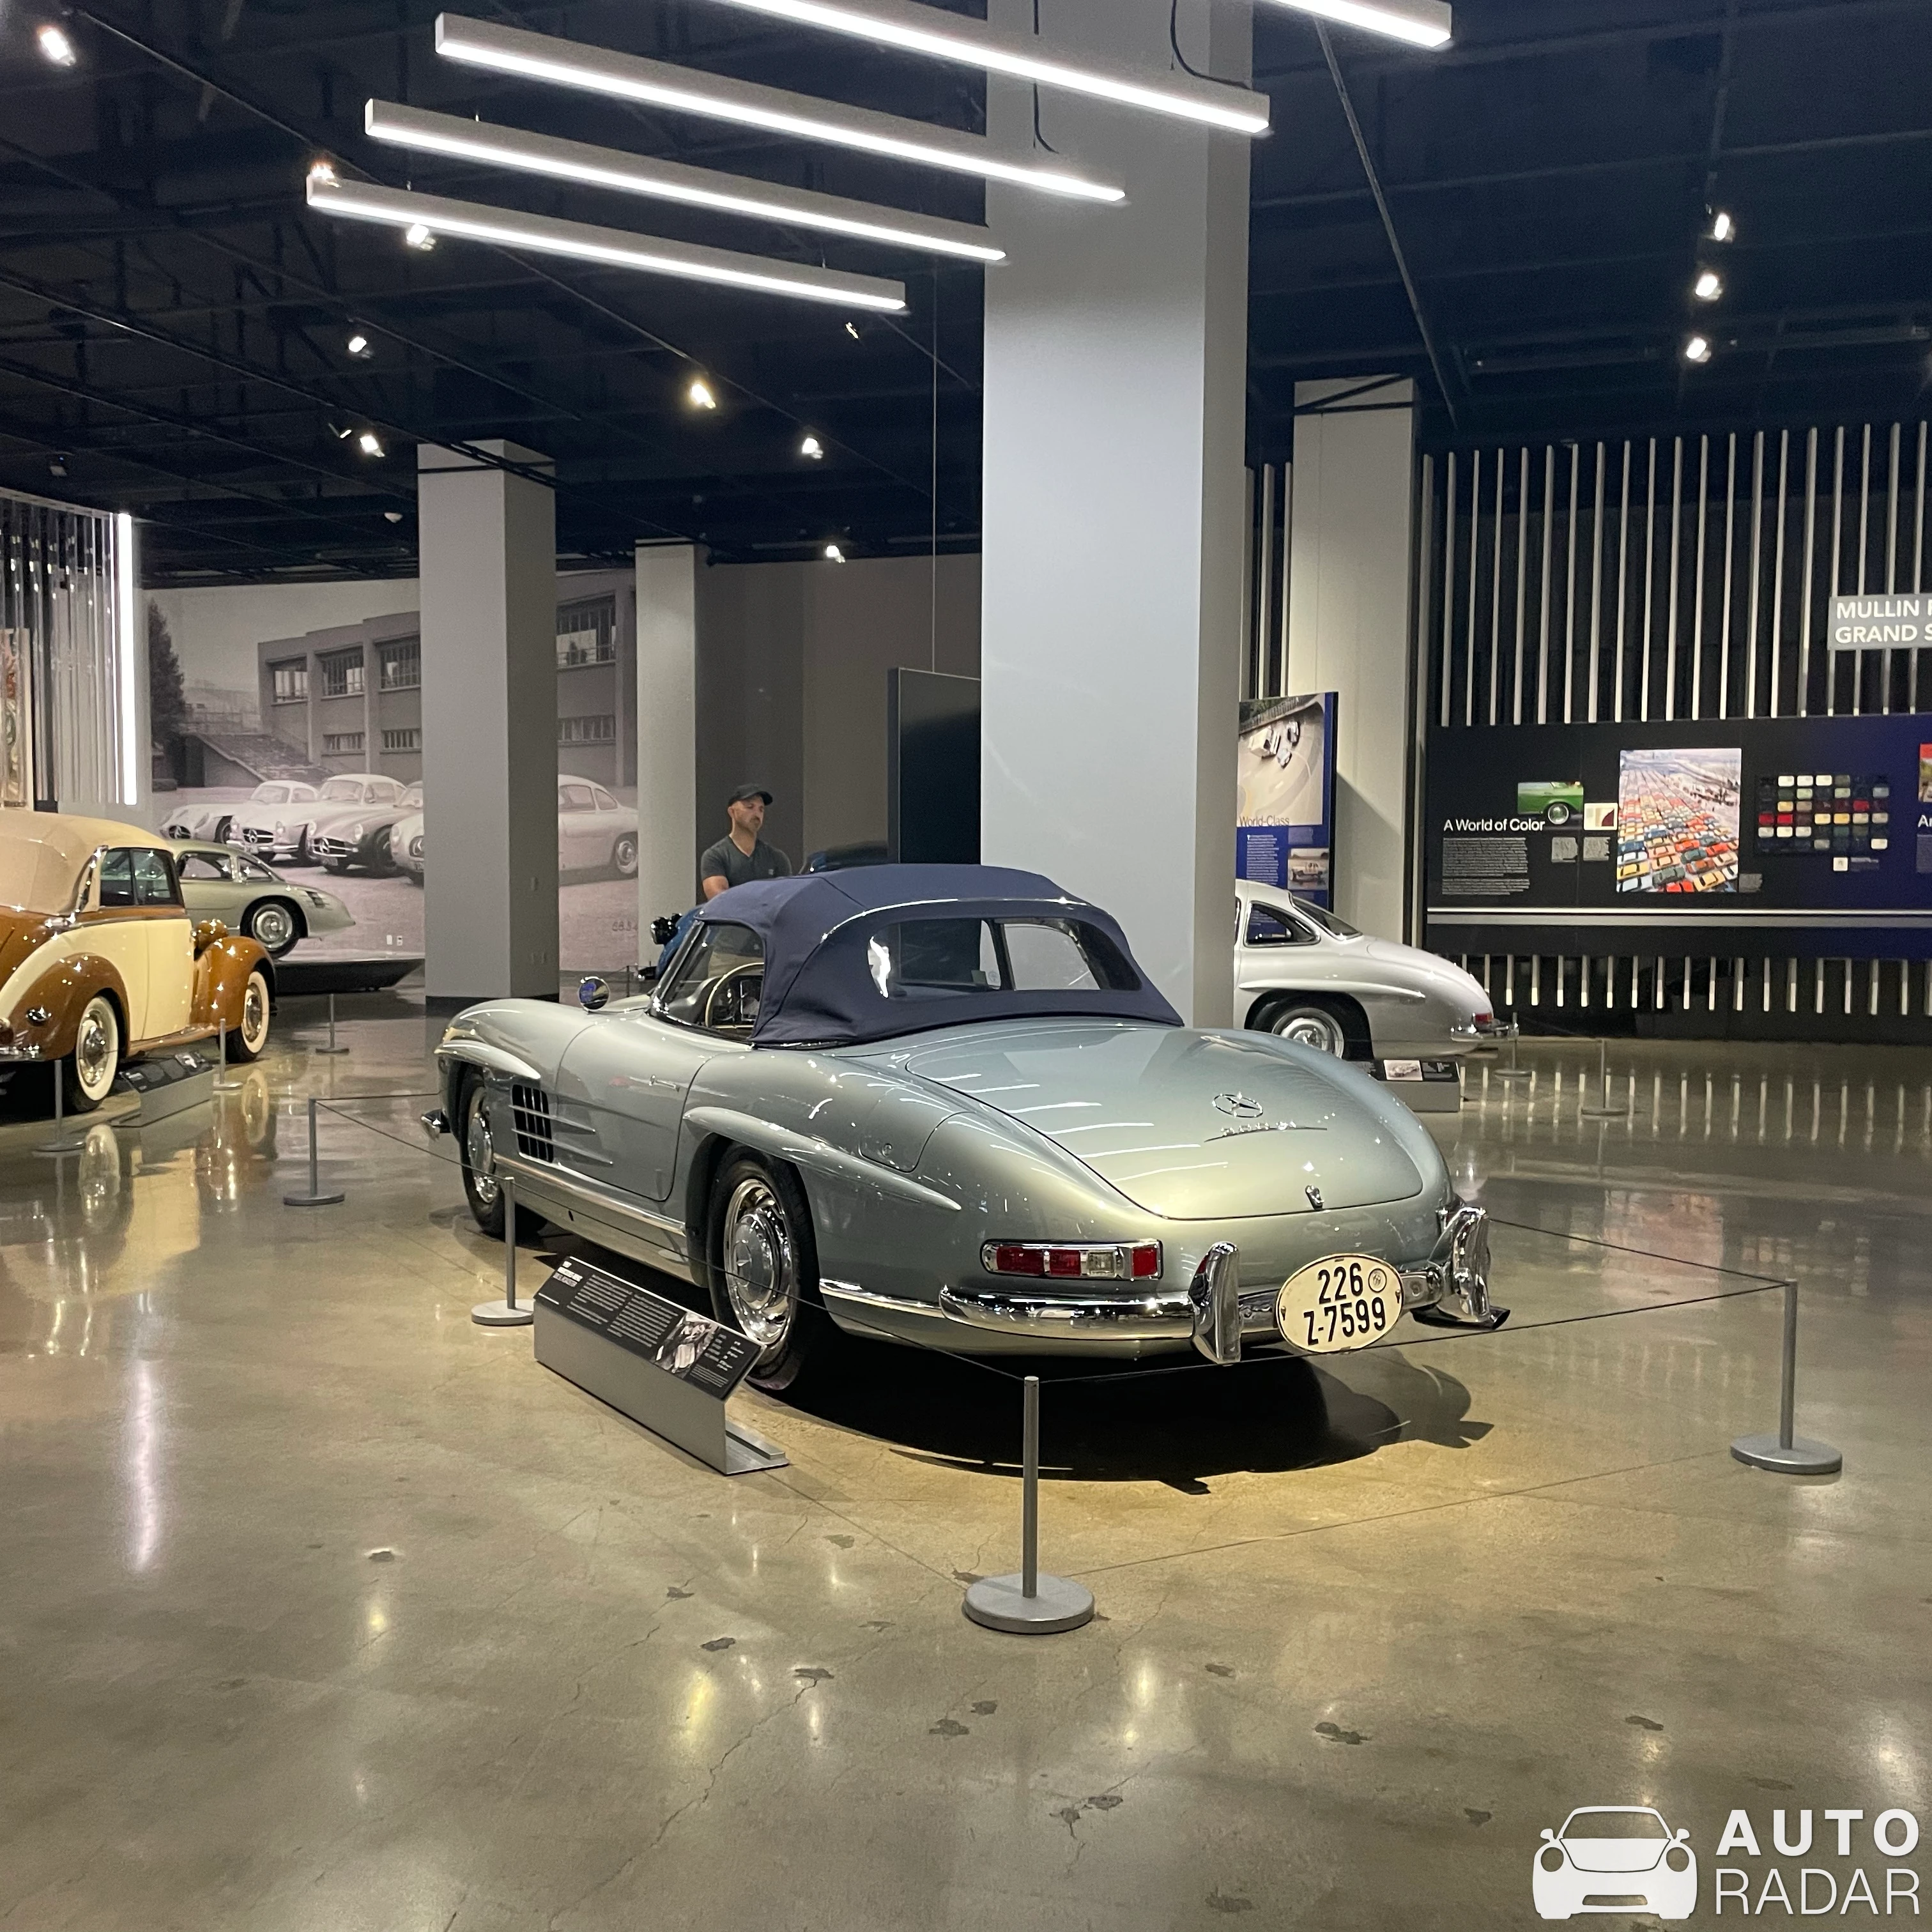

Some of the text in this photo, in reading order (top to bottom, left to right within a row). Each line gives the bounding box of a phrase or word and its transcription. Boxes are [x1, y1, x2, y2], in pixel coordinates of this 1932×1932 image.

[1836, 599, 1920, 619] MULLIN
[1835, 624, 1918, 643] GRAND
[1239, 815, 1290, 827] World-Class
[1443, 818, 1545, 831] A World of Color
[1317, 1262, 1363, 1305] 226
[1303, 1297, 1386, 1346] Z-7599
